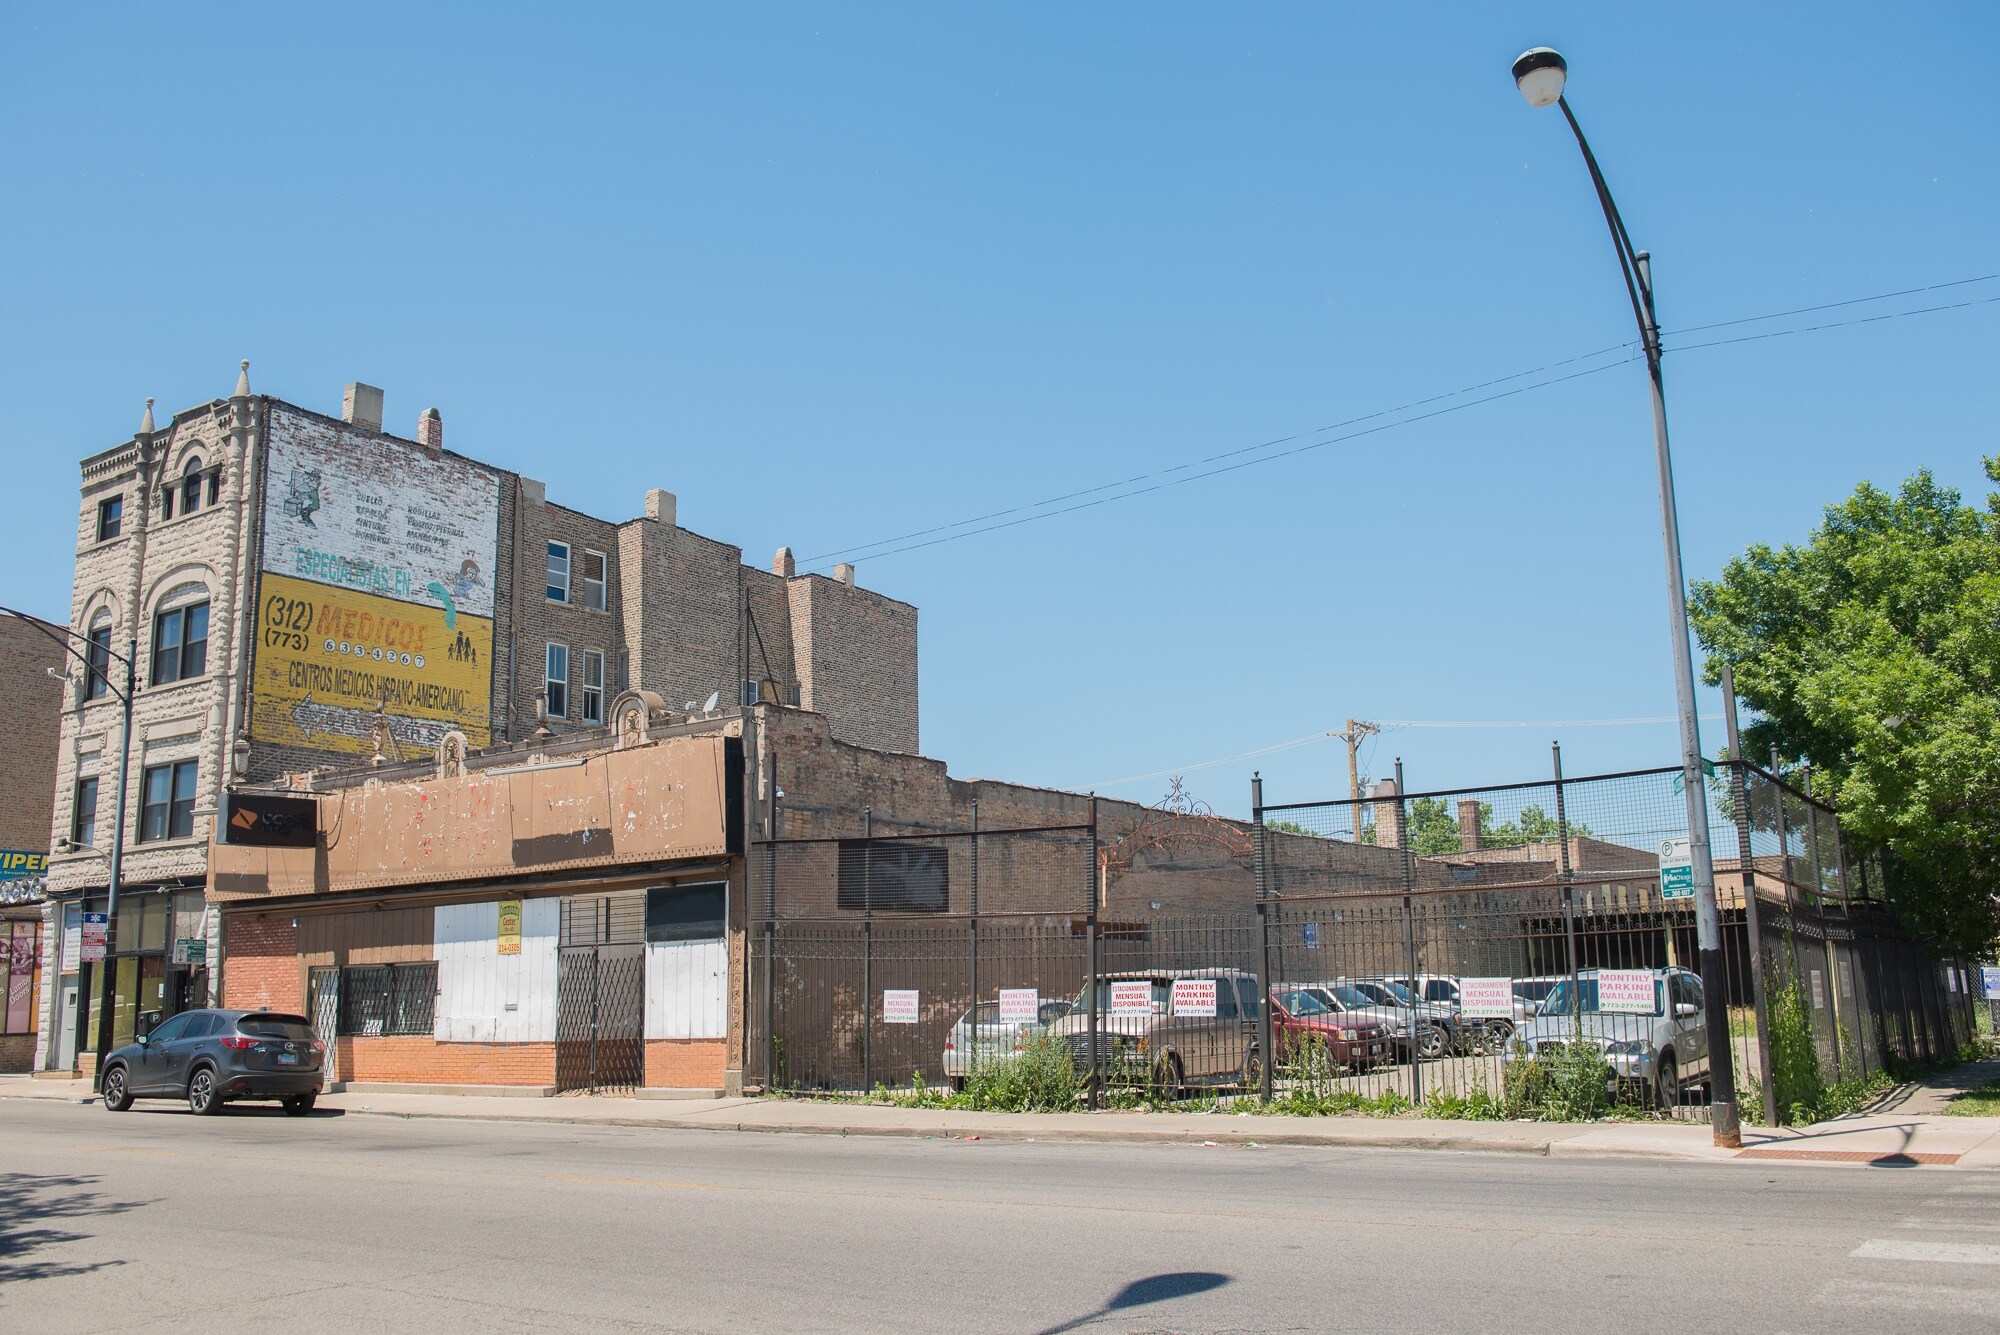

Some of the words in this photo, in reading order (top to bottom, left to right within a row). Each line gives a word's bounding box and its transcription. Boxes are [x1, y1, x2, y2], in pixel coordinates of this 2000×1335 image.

[407, 505, 441, 521] RODILLAS
[355, 517, 387, 533] CINTURA
[296, 547, 389, 592] ESPECIALISTAS
[394, 569, 411, 596] EN
[266, 594, 314, 633] (312)
[316, 603, 429, 652] MEDICOS
[265, 627, 309, 652] (773)
[288, 660, 333, 693] CENTROS
[334, 668, 375, 699] MEDICOS
[376, 675, 464, 712] HISPANO-AMERICANO
[503, 918, 516, 926] Center
[1600, 974, 1650, 982] MONTHLY
[9, 975, 31, 996] Lambo
[1112, 984, 1151, 993] ESTACIONAMIENTO
[1175, 983, 1214, 991] MONTHLY
[1461, 981, 1510, 989] ESTACIONAMIENTO
[1599, 983, 1652, 992] PARKING
[9, 987, 30, 1006] Doors
[1115, 992, 1147, 1000] MENSUAL
[1175, 991, 1215, 999] PARKING
[1466, 990, 1507, 998] MENSUAL
[1599, 992, 1653, 1001] AVAILABLE
[1112, 1000, 1151, 1008] DISPONIBLE
[1175, 999, 1215, 1007] AVAILABLE
[1462, 999, 1511, 1007] DISPONIBLE
